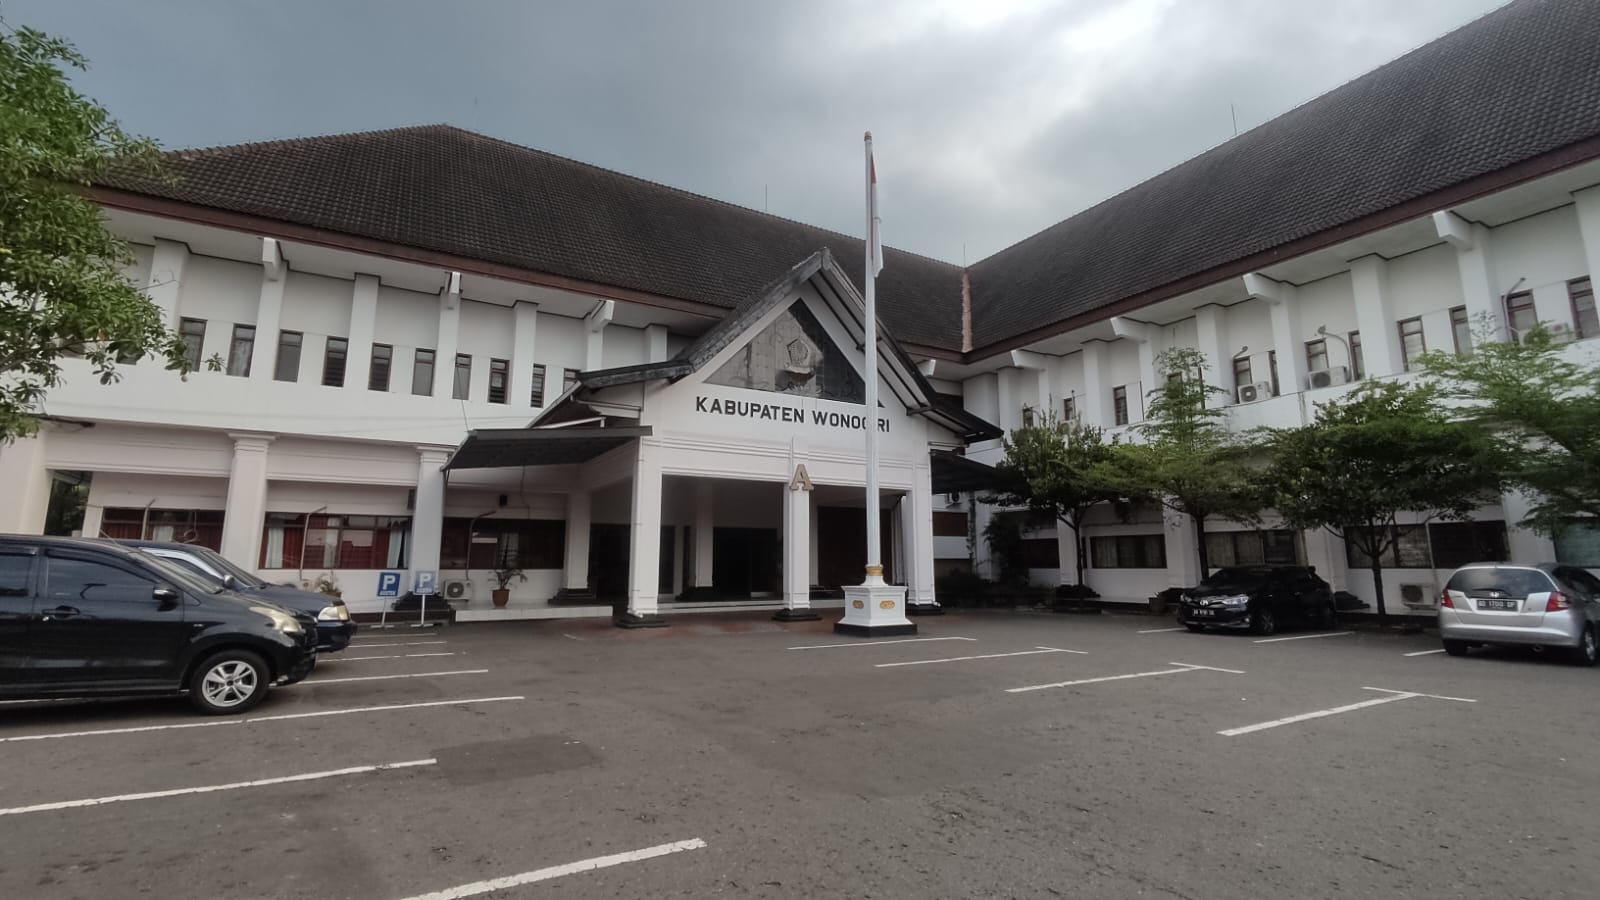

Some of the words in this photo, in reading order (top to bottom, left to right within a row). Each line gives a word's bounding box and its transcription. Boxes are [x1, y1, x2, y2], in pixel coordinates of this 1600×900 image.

[696, 396, 804, 423] KABUPATEN
[789, 464, 815, 491] A
[382, 574, 396, 590] P
[419, 573, 432, 588] P
